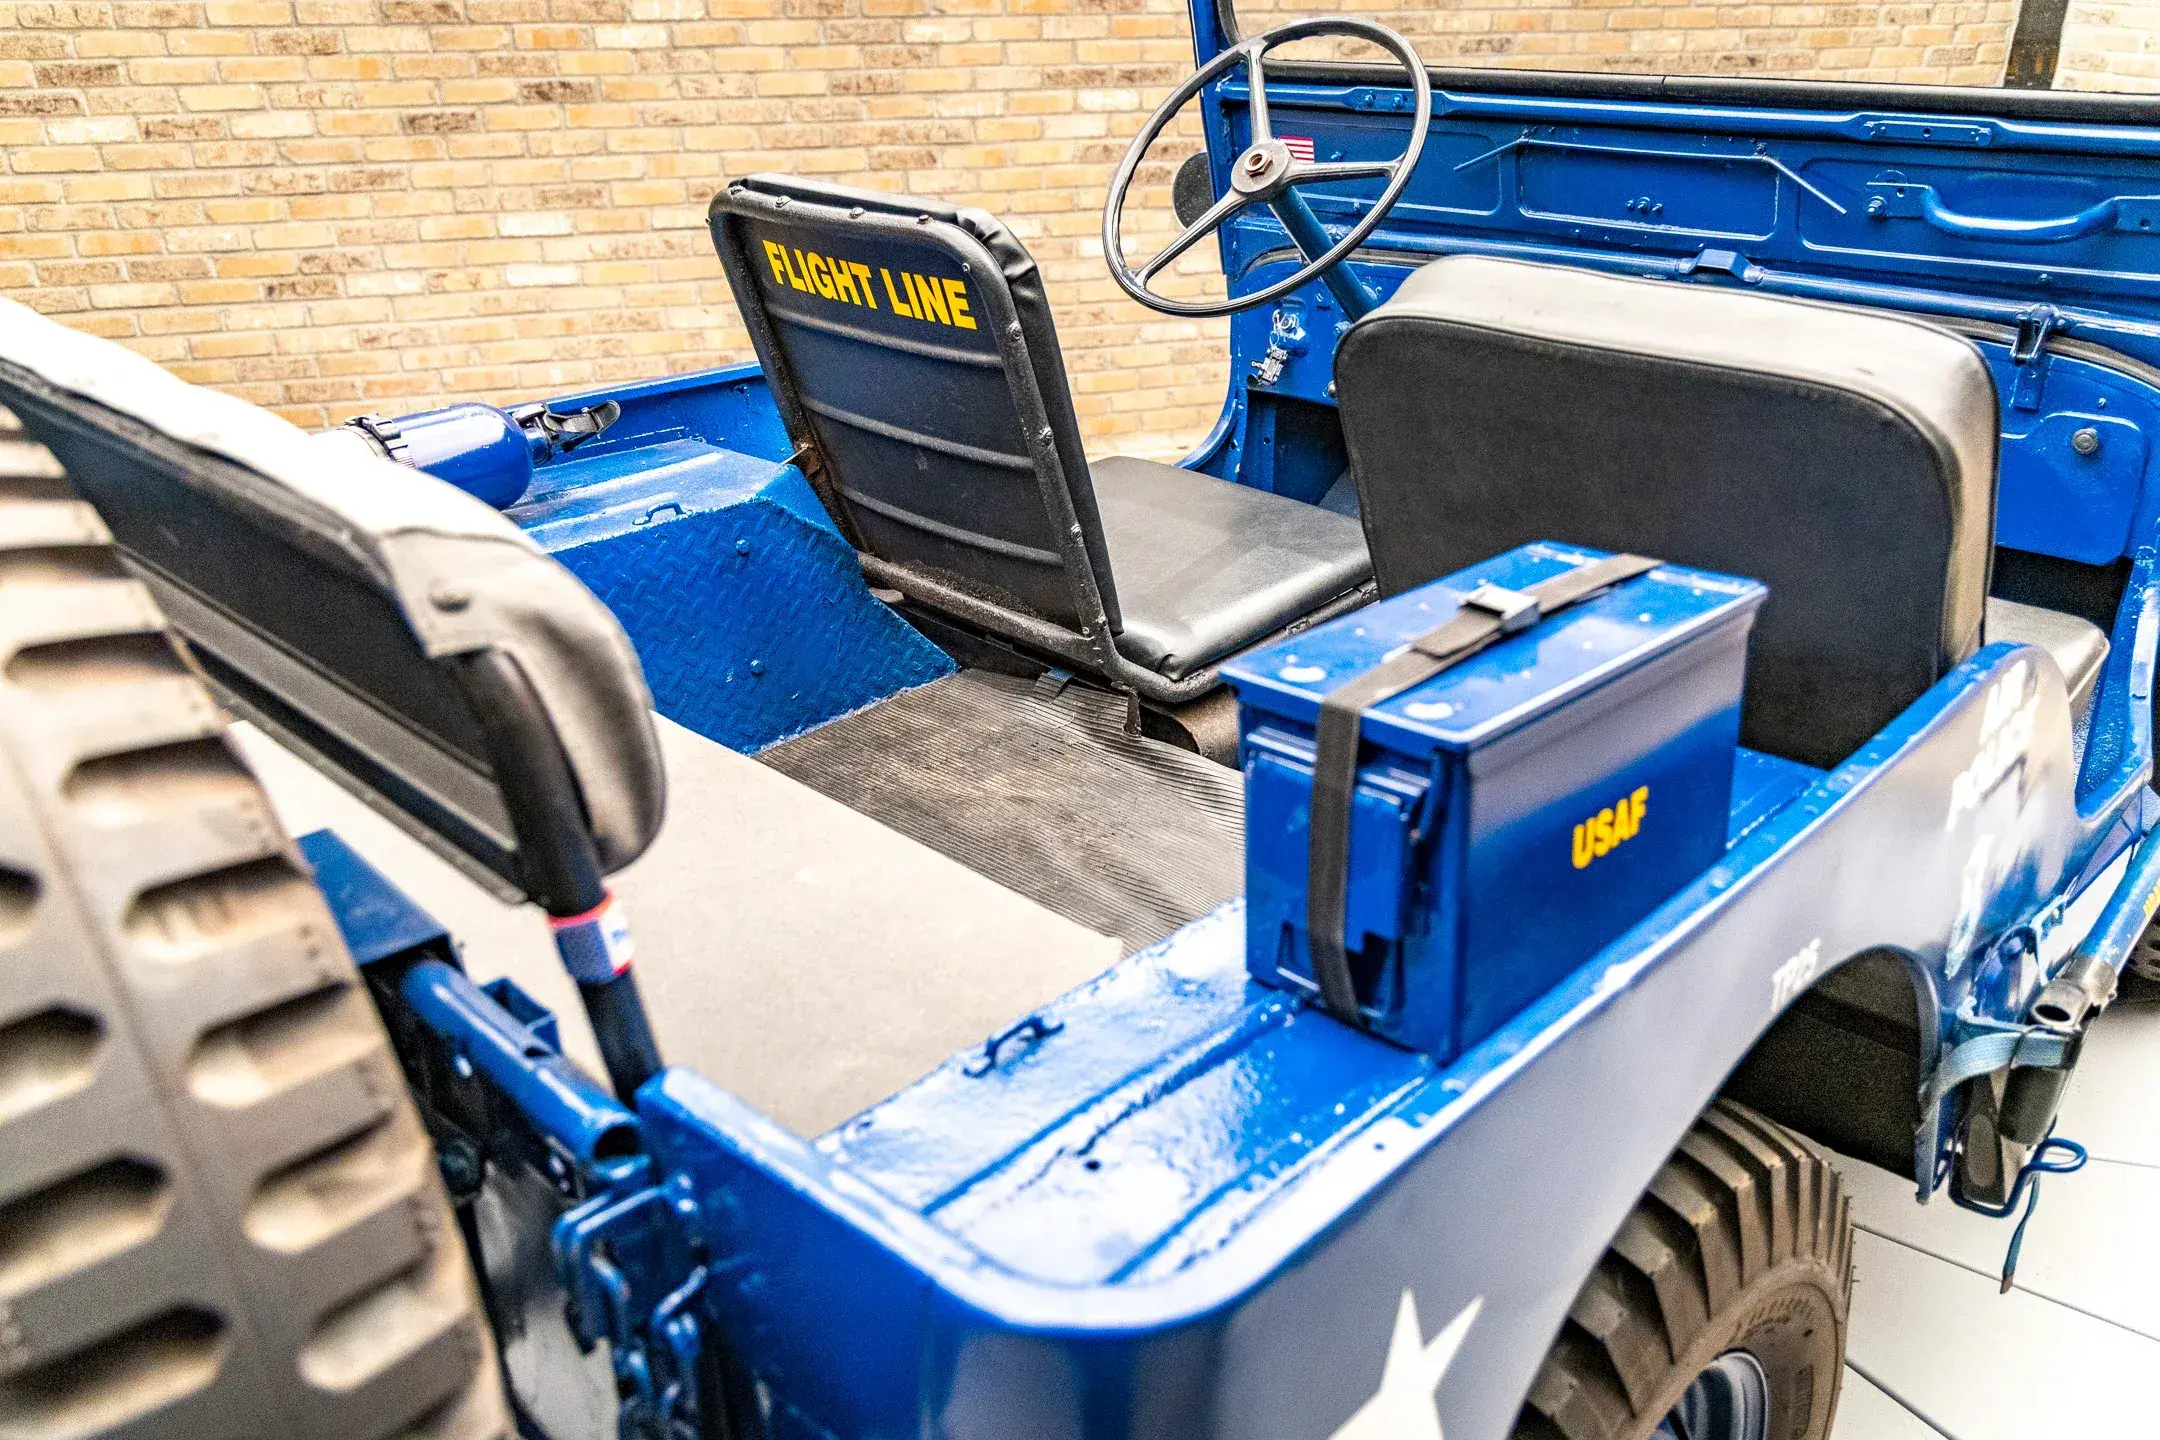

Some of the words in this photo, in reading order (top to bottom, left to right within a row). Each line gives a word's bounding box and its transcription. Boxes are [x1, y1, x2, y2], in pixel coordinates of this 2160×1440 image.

[762, 240, 878, 310] FLIGHT
[880, 268, 978, 330] LINE
[1571, 785, 1650, 870] USAF
